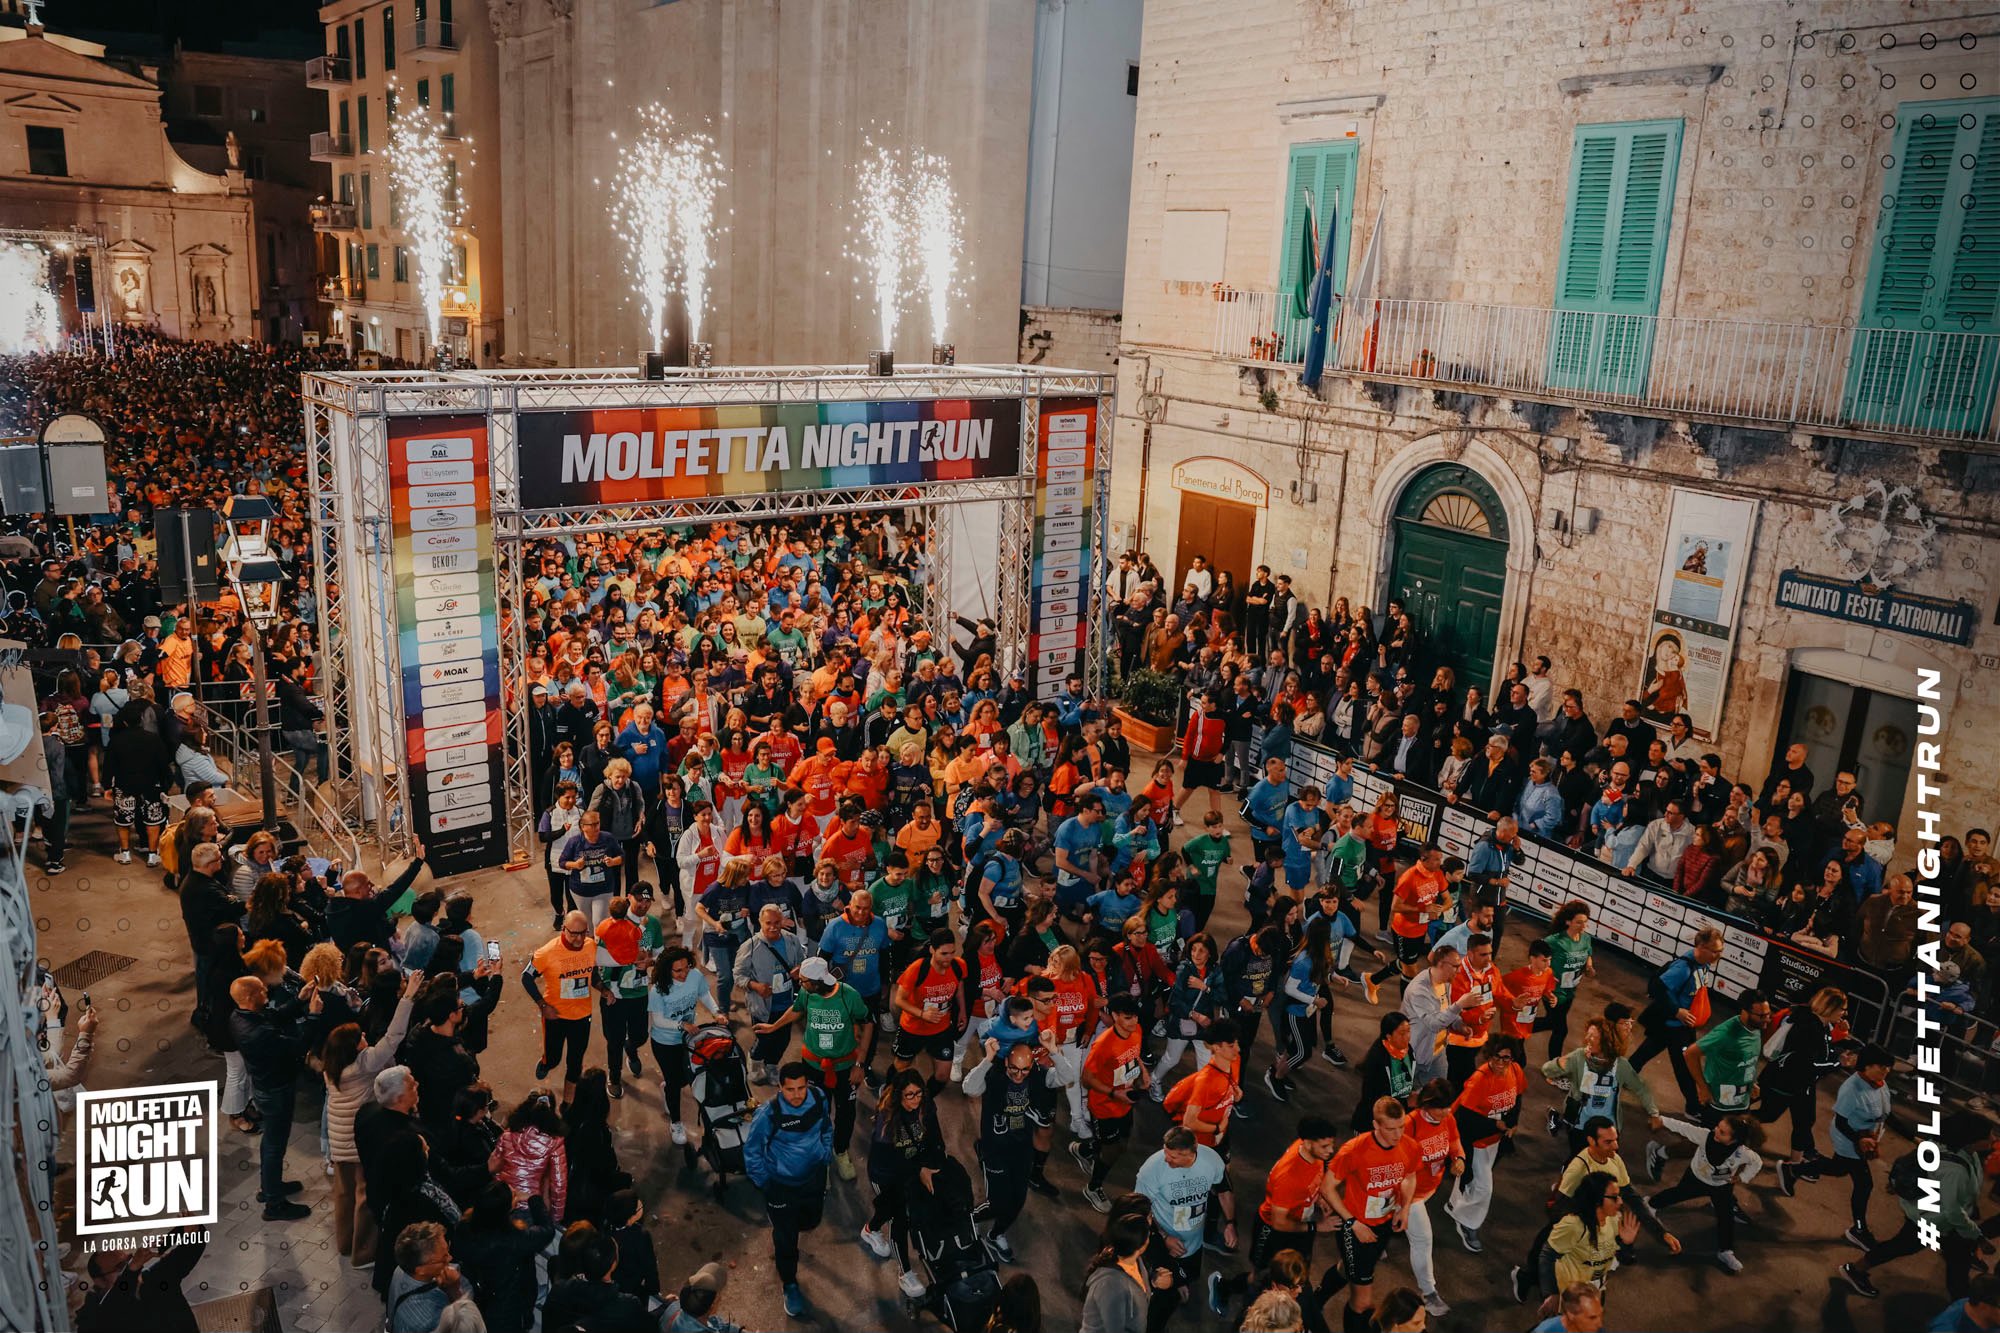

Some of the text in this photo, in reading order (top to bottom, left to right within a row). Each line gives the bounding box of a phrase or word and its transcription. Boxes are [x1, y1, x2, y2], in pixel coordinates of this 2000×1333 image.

[561, 426, 791, 483] MOLFETTA
[1220, 476, 1232, 493] del
[1234, 480, 1263, 503] Borgo
[428, 536, 460, 545] Casillo
[1781, 581, 1841, 612] COMITATO
[1844, 592, 1885, 622] FESTE
[1888, 602, 1964, 638] PATRONALI
[1985, 657, 1995, 666] 13
[444, 667, 468, 676] MOAK
[1403, 799, 1431, 814] MOLFETTA
[1401, 806, 1430, 825] NIGHT
[1544, 887, 1558, 897] MOAK
[559, 966, 593, 979] ARRIVO
[1780, 955, 1819, 978] Studio360
[811, 1008, 841, 1017] PRIMA
[1057, 1004, 1084, 1012] RRIVO
[811, 1022, 844, 1030] ARRIVO
[1422, 1147, 1449, 1162] ARRIV
[1367, 1162, 1405, 1176] PRIMA
[1169, 1176, 1207, 1191] PRIMA
[1370, 1174, 1381, 1183] O
[1172, 1190, 1183, 1199] O
